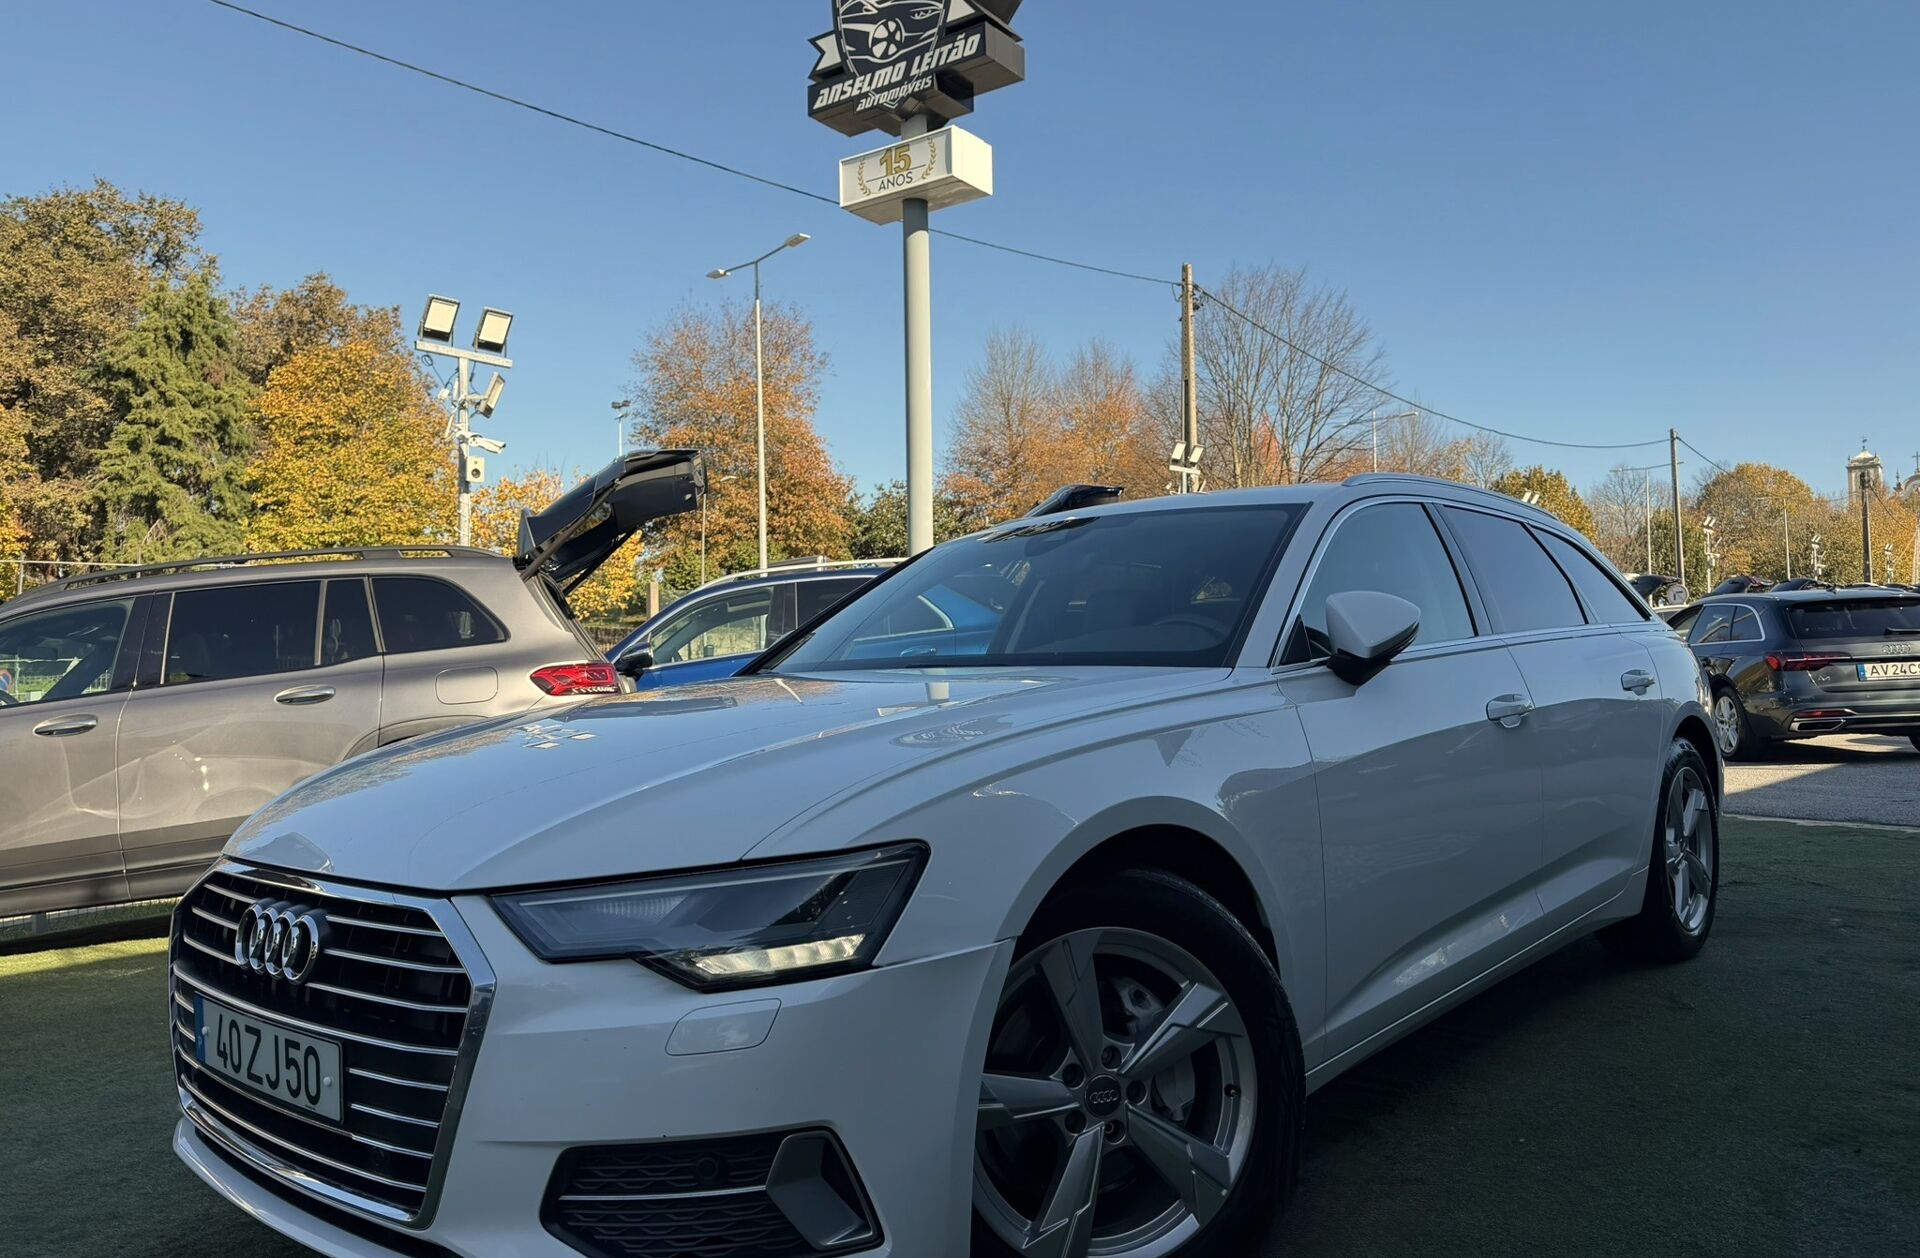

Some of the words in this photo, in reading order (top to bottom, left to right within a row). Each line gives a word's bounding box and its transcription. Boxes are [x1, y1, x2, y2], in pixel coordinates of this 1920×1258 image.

[813, 61, 907, 110] ANSELMO
[910, 33, 981, 76] LEITÃO
[880, 144, 912, 177] 15
[878, 171, 913, 192] ANOS
